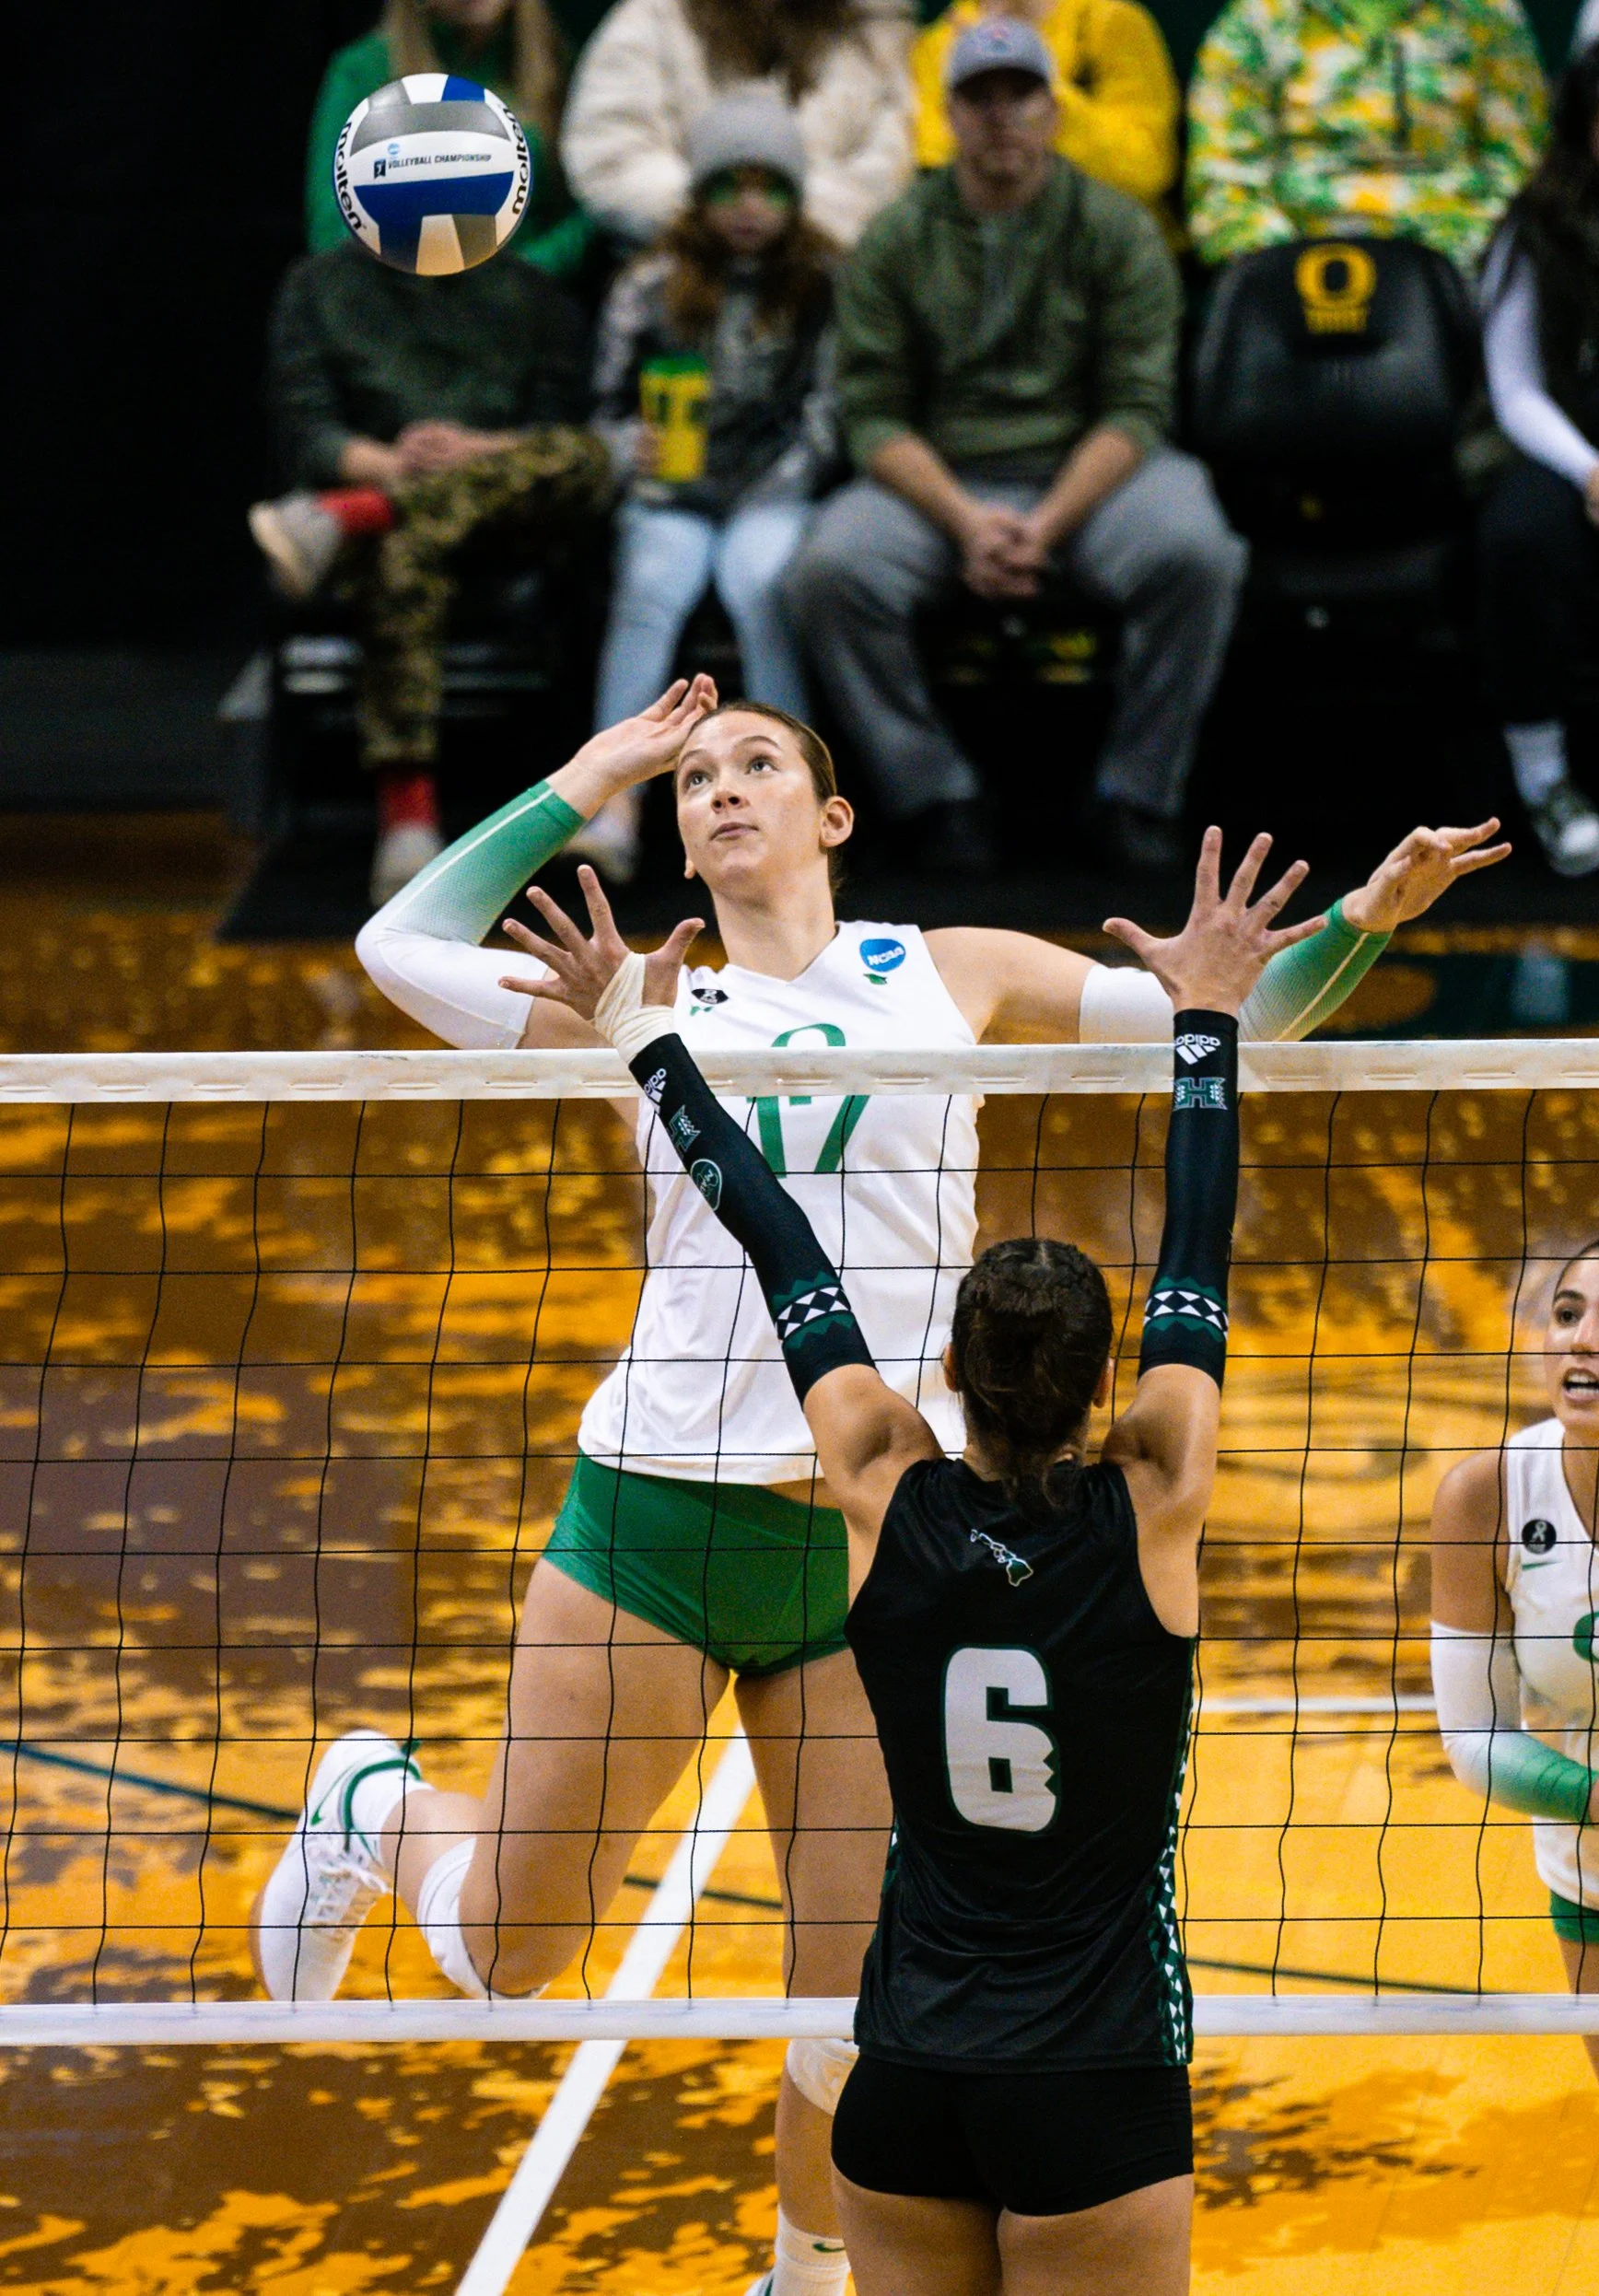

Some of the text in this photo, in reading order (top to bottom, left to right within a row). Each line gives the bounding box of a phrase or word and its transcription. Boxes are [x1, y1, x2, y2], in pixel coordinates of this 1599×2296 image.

[335, 122, 363, 229] molten
[388, 153, 492, 169] VOLLEYBALL CHAMPIONSHIP
[944, 1646, 1056, 1832] 6
